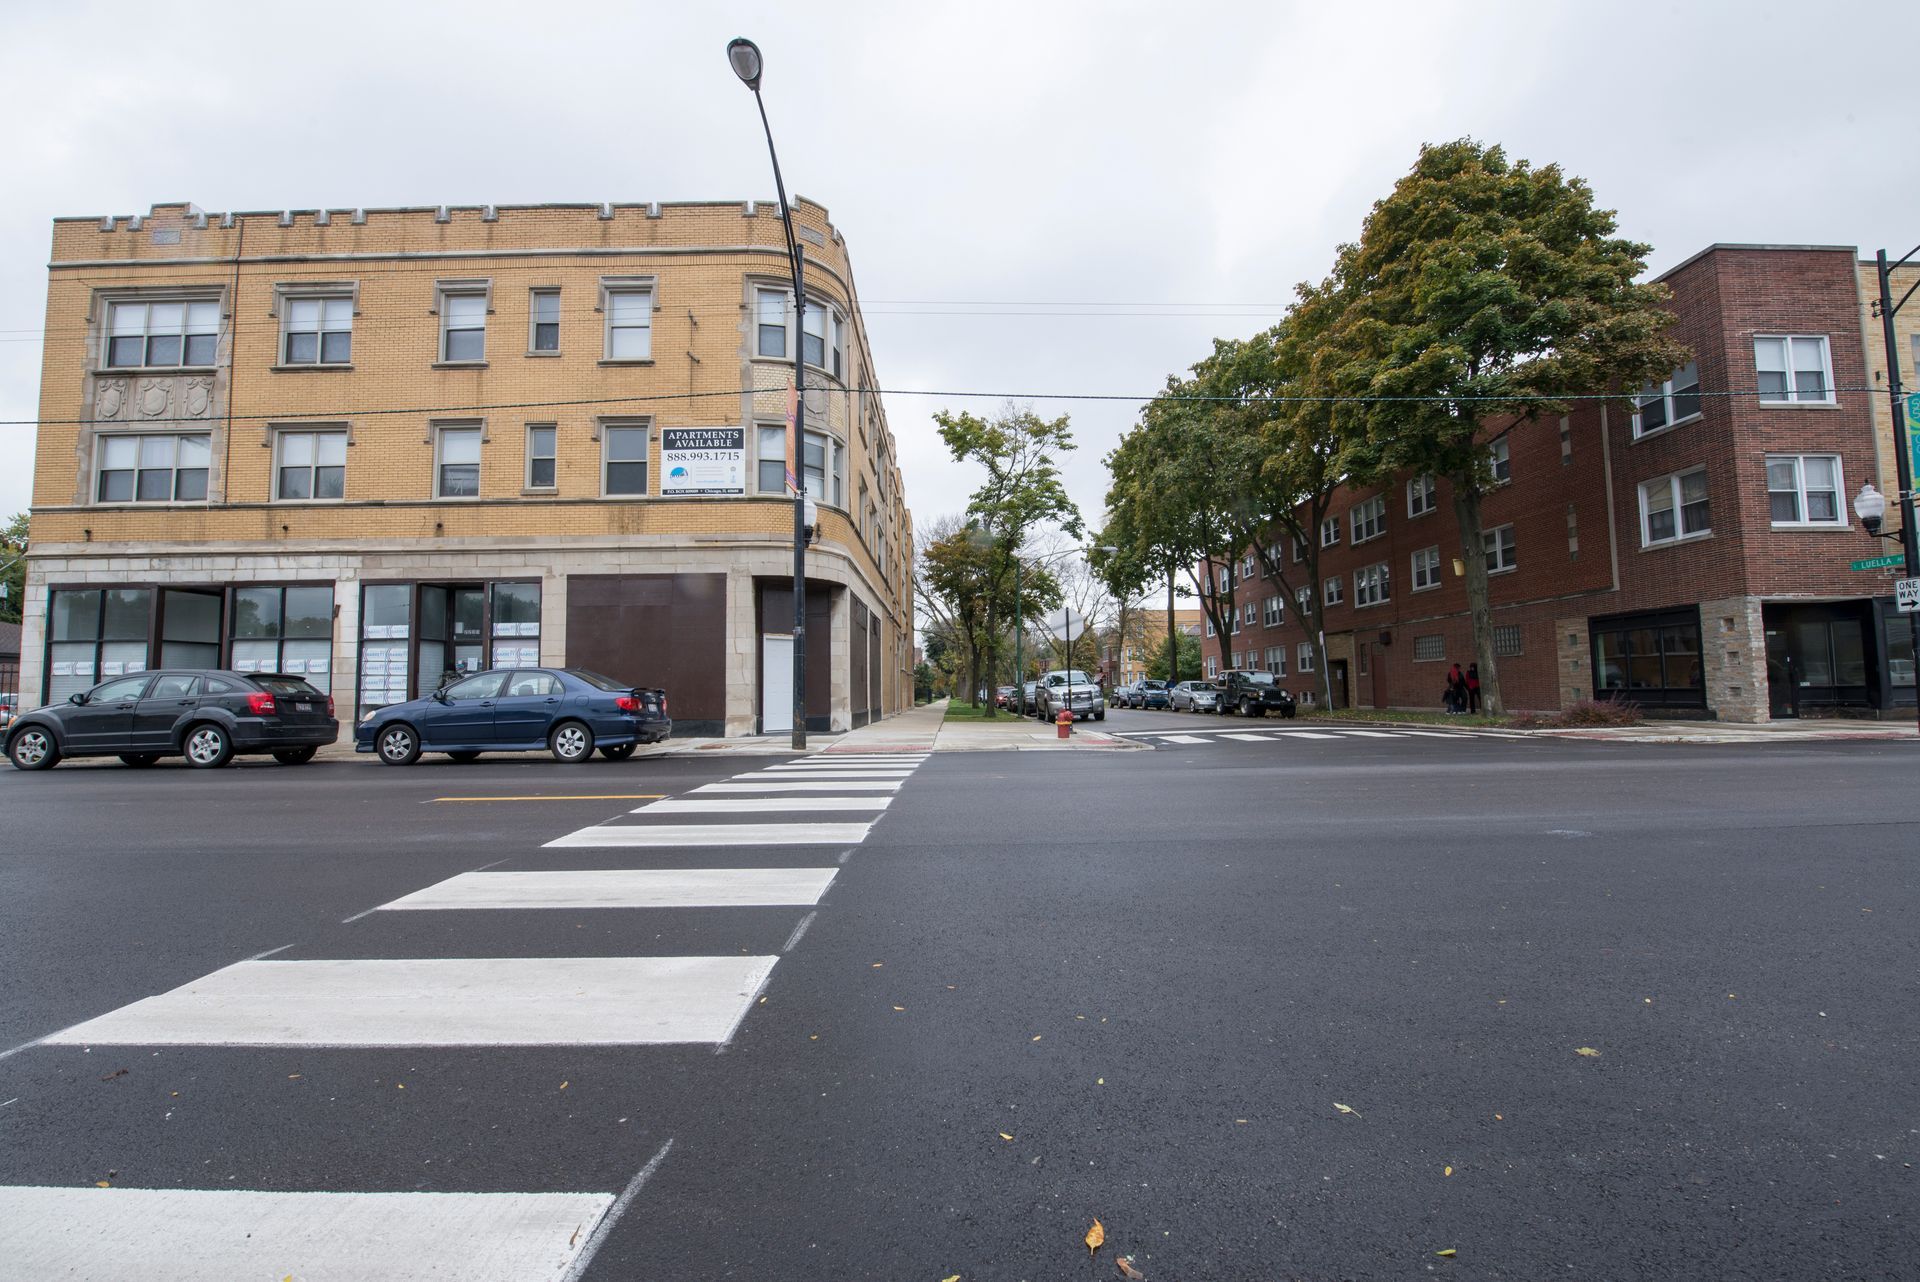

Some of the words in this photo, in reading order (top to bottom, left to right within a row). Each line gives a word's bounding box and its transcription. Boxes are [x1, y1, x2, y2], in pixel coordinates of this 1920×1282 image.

[668, 431, 739, 439] APARTMENTS
[675, 439, 732, 447] AVAILABLE
[667, 452, 740, 461] 888.993.1715
[1861, 557, 1892, 569] LUELLA
[1899, 581, 1918, 590] ONE
[1899, 590, 1919, 599] WAY
